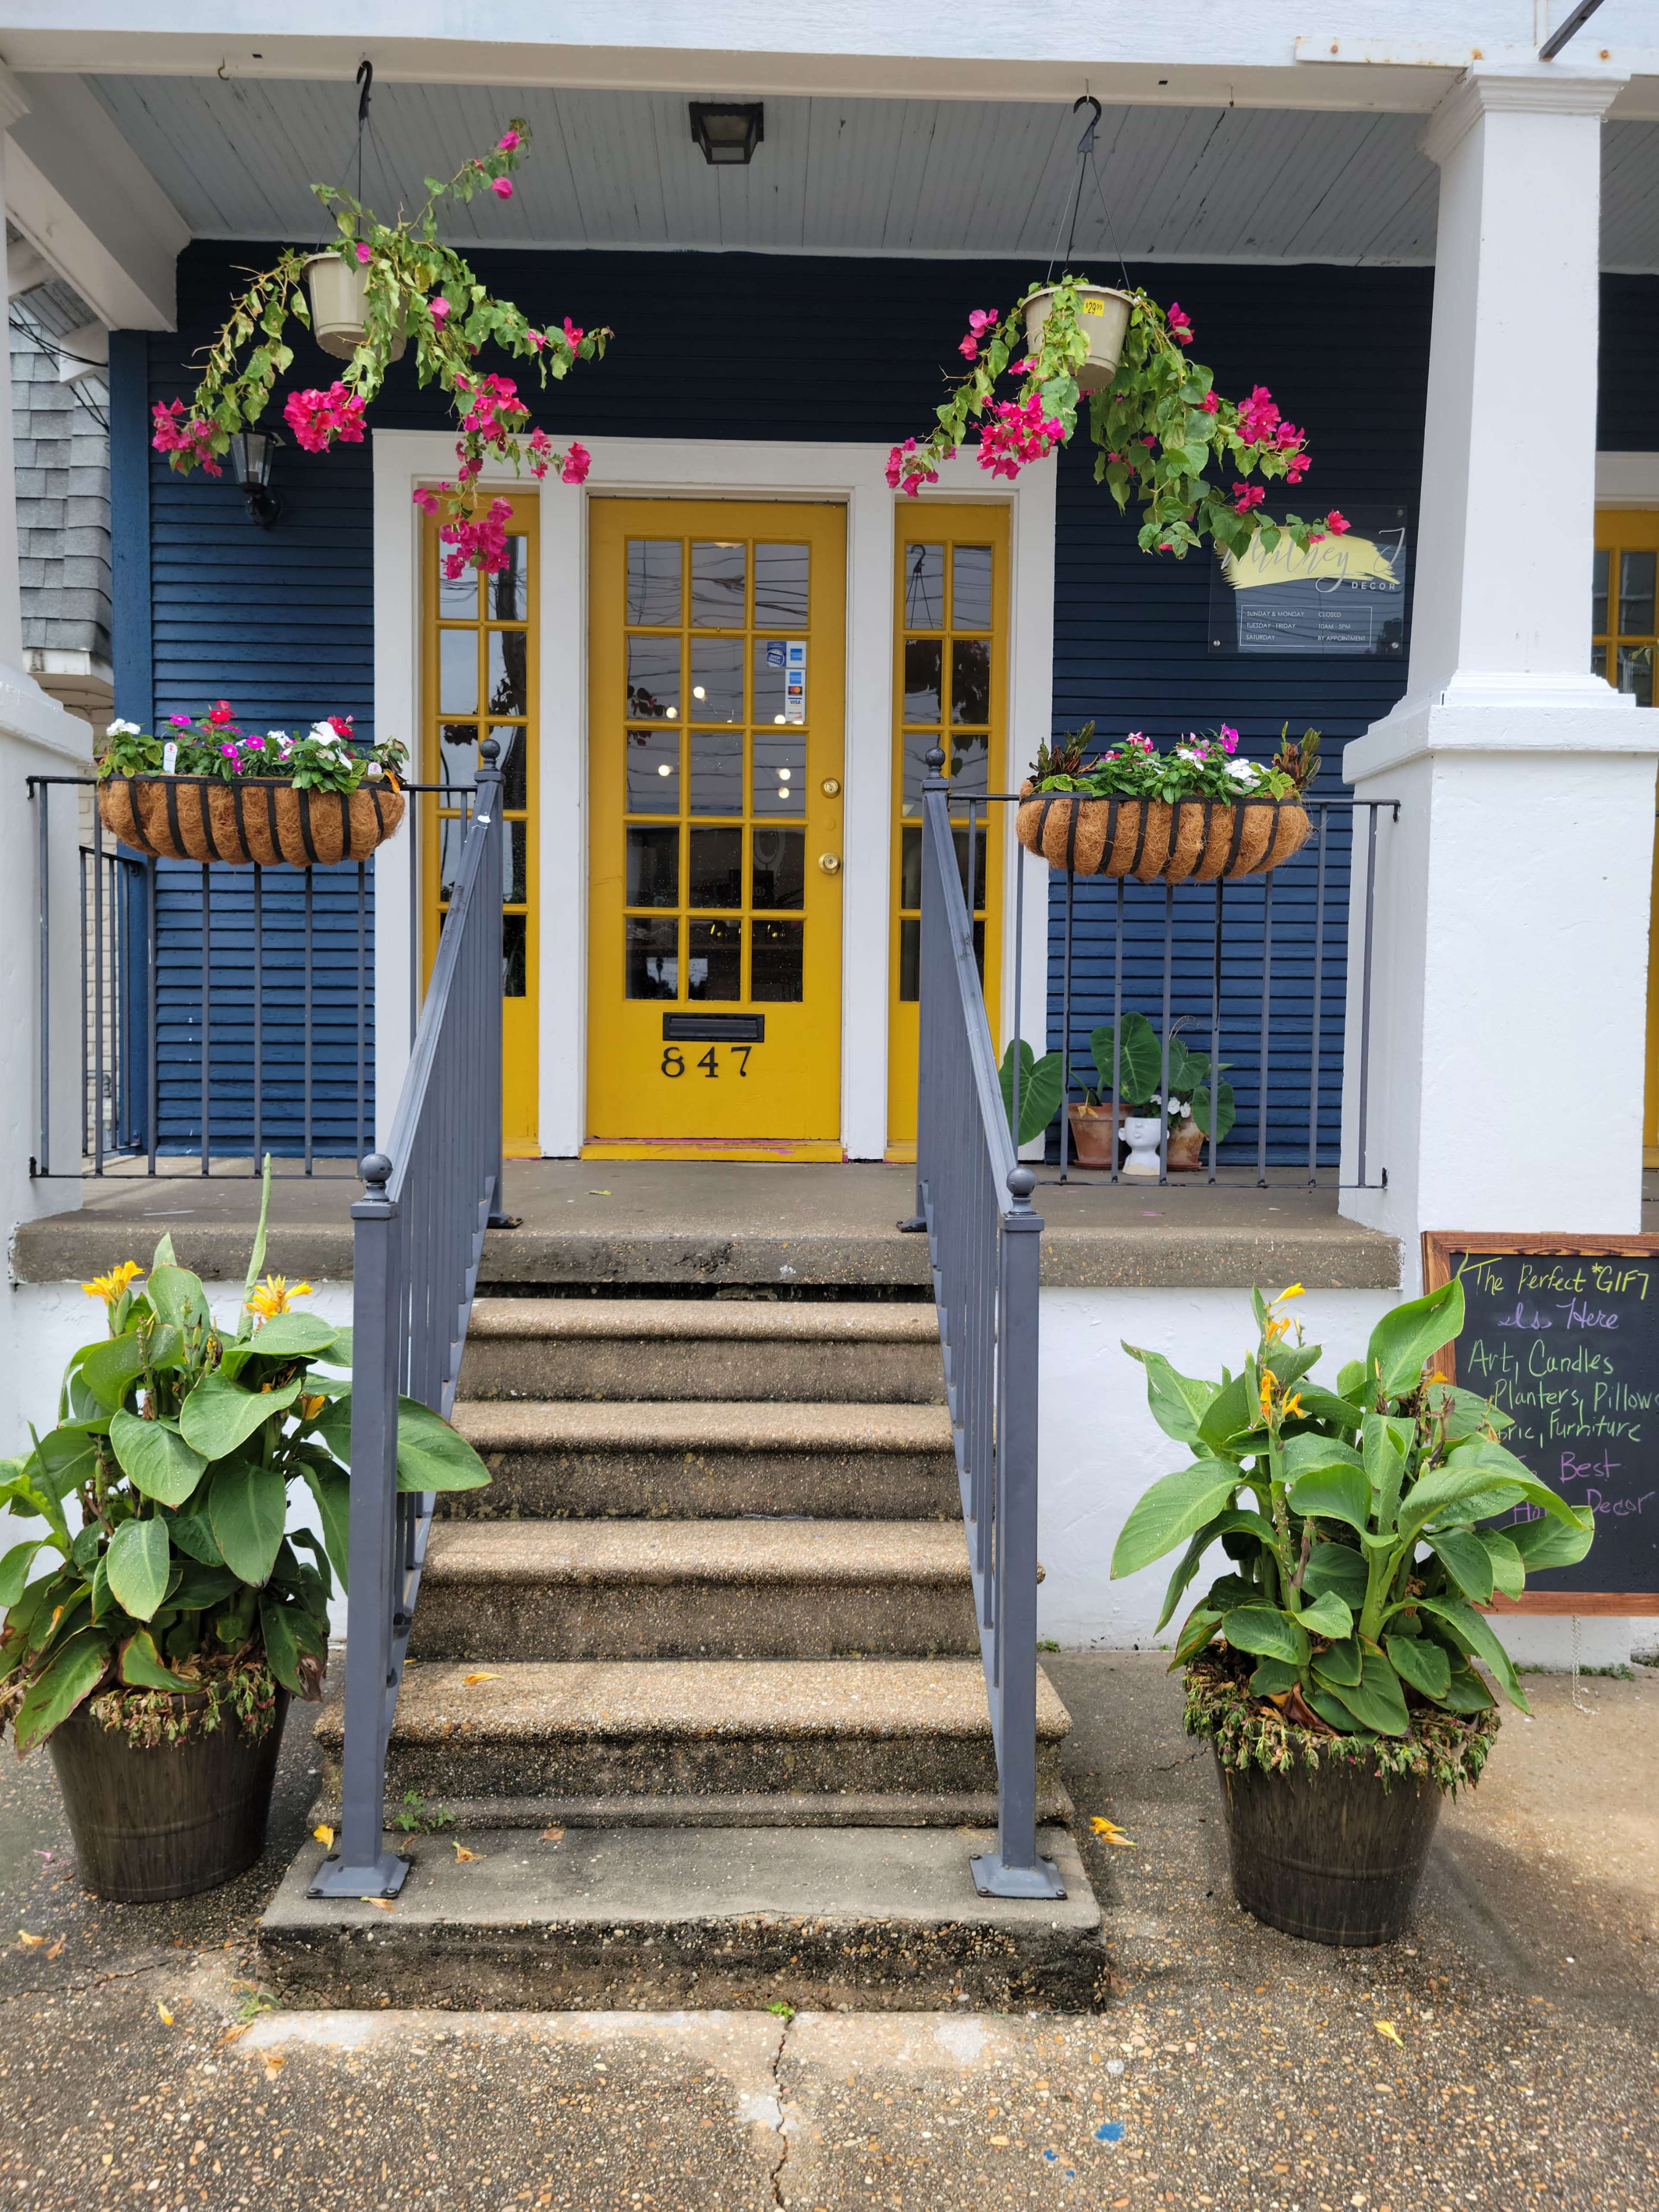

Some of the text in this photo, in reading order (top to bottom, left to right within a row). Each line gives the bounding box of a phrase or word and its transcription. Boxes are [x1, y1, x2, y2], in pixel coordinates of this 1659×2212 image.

[1351, 582, 1395, 591] DECOR
[661, 1046, 752, 1077] 847
[1462, 1257, 1504, 1296] The
[1518, 1263, 1586, 1294] Perfect
[1556, 1297, 1619, 1329] Here
[1529, 1339, 1614, 1377] Candles
[1550, 1409, 1641, 1442] Furniture
[1559, 1448, 1621, 1484] Best
[1586, 1489, 1655, 1516] Decor
